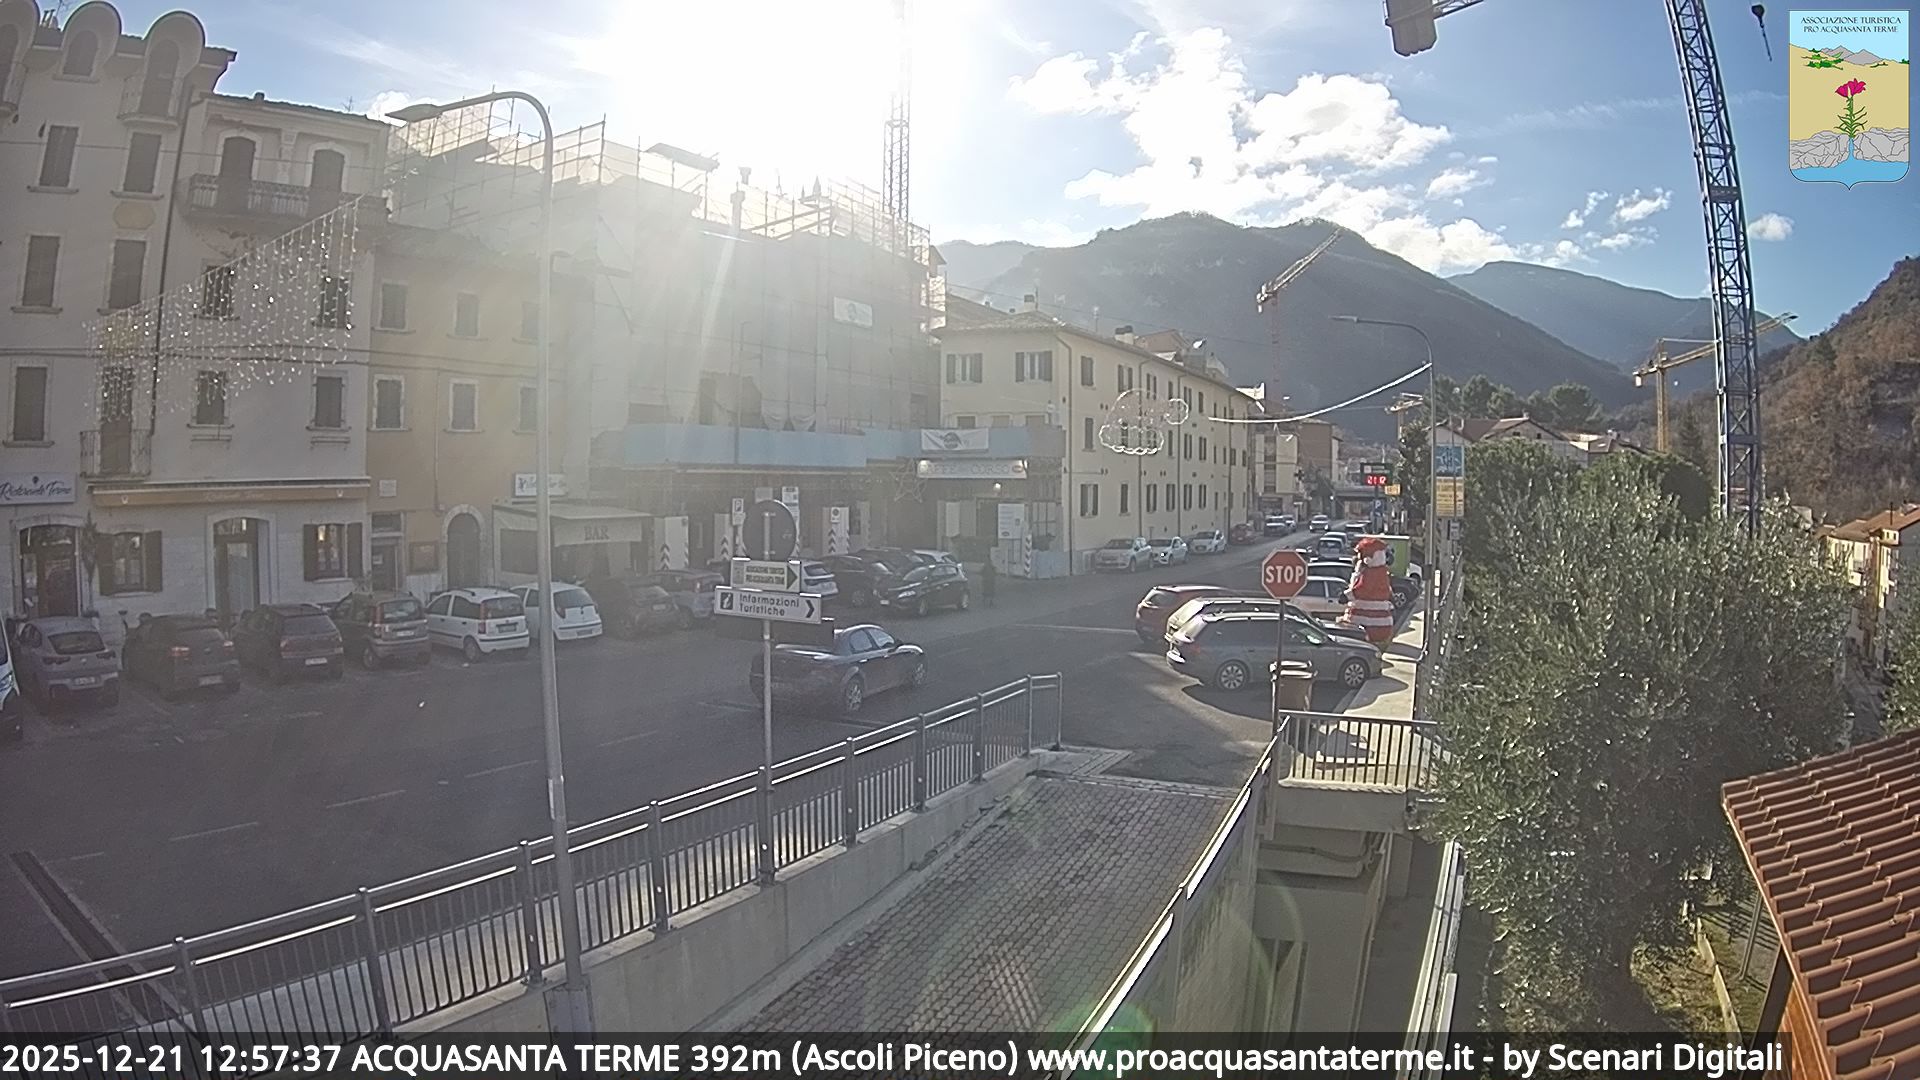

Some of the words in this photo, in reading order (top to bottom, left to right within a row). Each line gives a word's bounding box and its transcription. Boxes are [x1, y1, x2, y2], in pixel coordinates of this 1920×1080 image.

[584, 525, 611, 541] BAR
[1265, 565, 1304, 584] STOP
[739, 593, 800, 608] Informazioni
[739, 603, 786, 616] Turistiche
